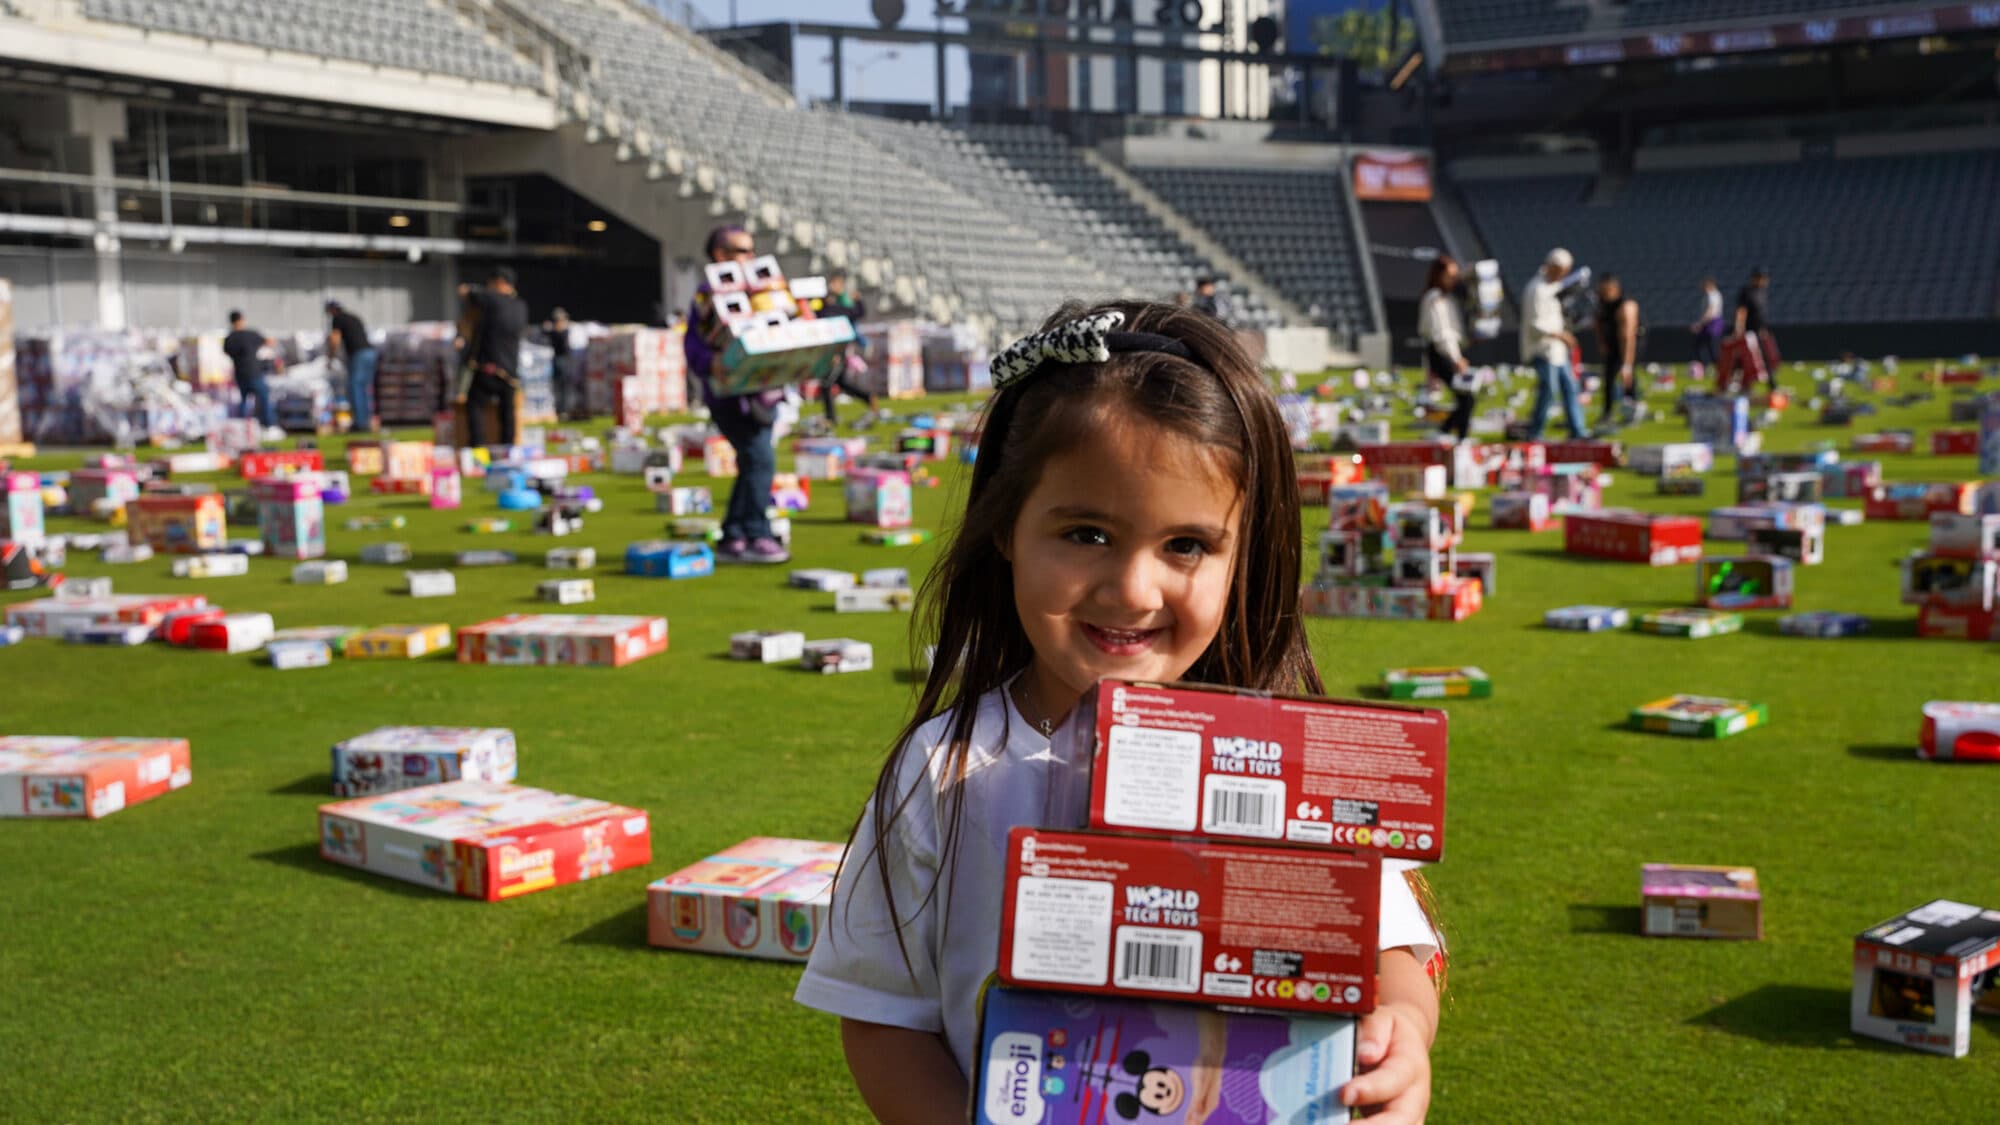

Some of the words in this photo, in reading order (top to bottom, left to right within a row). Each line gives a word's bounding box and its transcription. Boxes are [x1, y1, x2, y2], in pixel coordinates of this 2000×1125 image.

[1212, 736, 1282, 761] WORLD
[1212, 756, 1245, 773] TECH
[1248, 759, 1282, 776] TOYS
[1296, 801, 1323, 820] 6+
[1125, 886, 1200, 911] WORLD
[1124, 907, 1158, 924] TECH
[1164, 909, 1199, 927] TOYS
[1214, 952, 1243, 972] 6+
[1010, 1044, 1037, 1117] emoji
